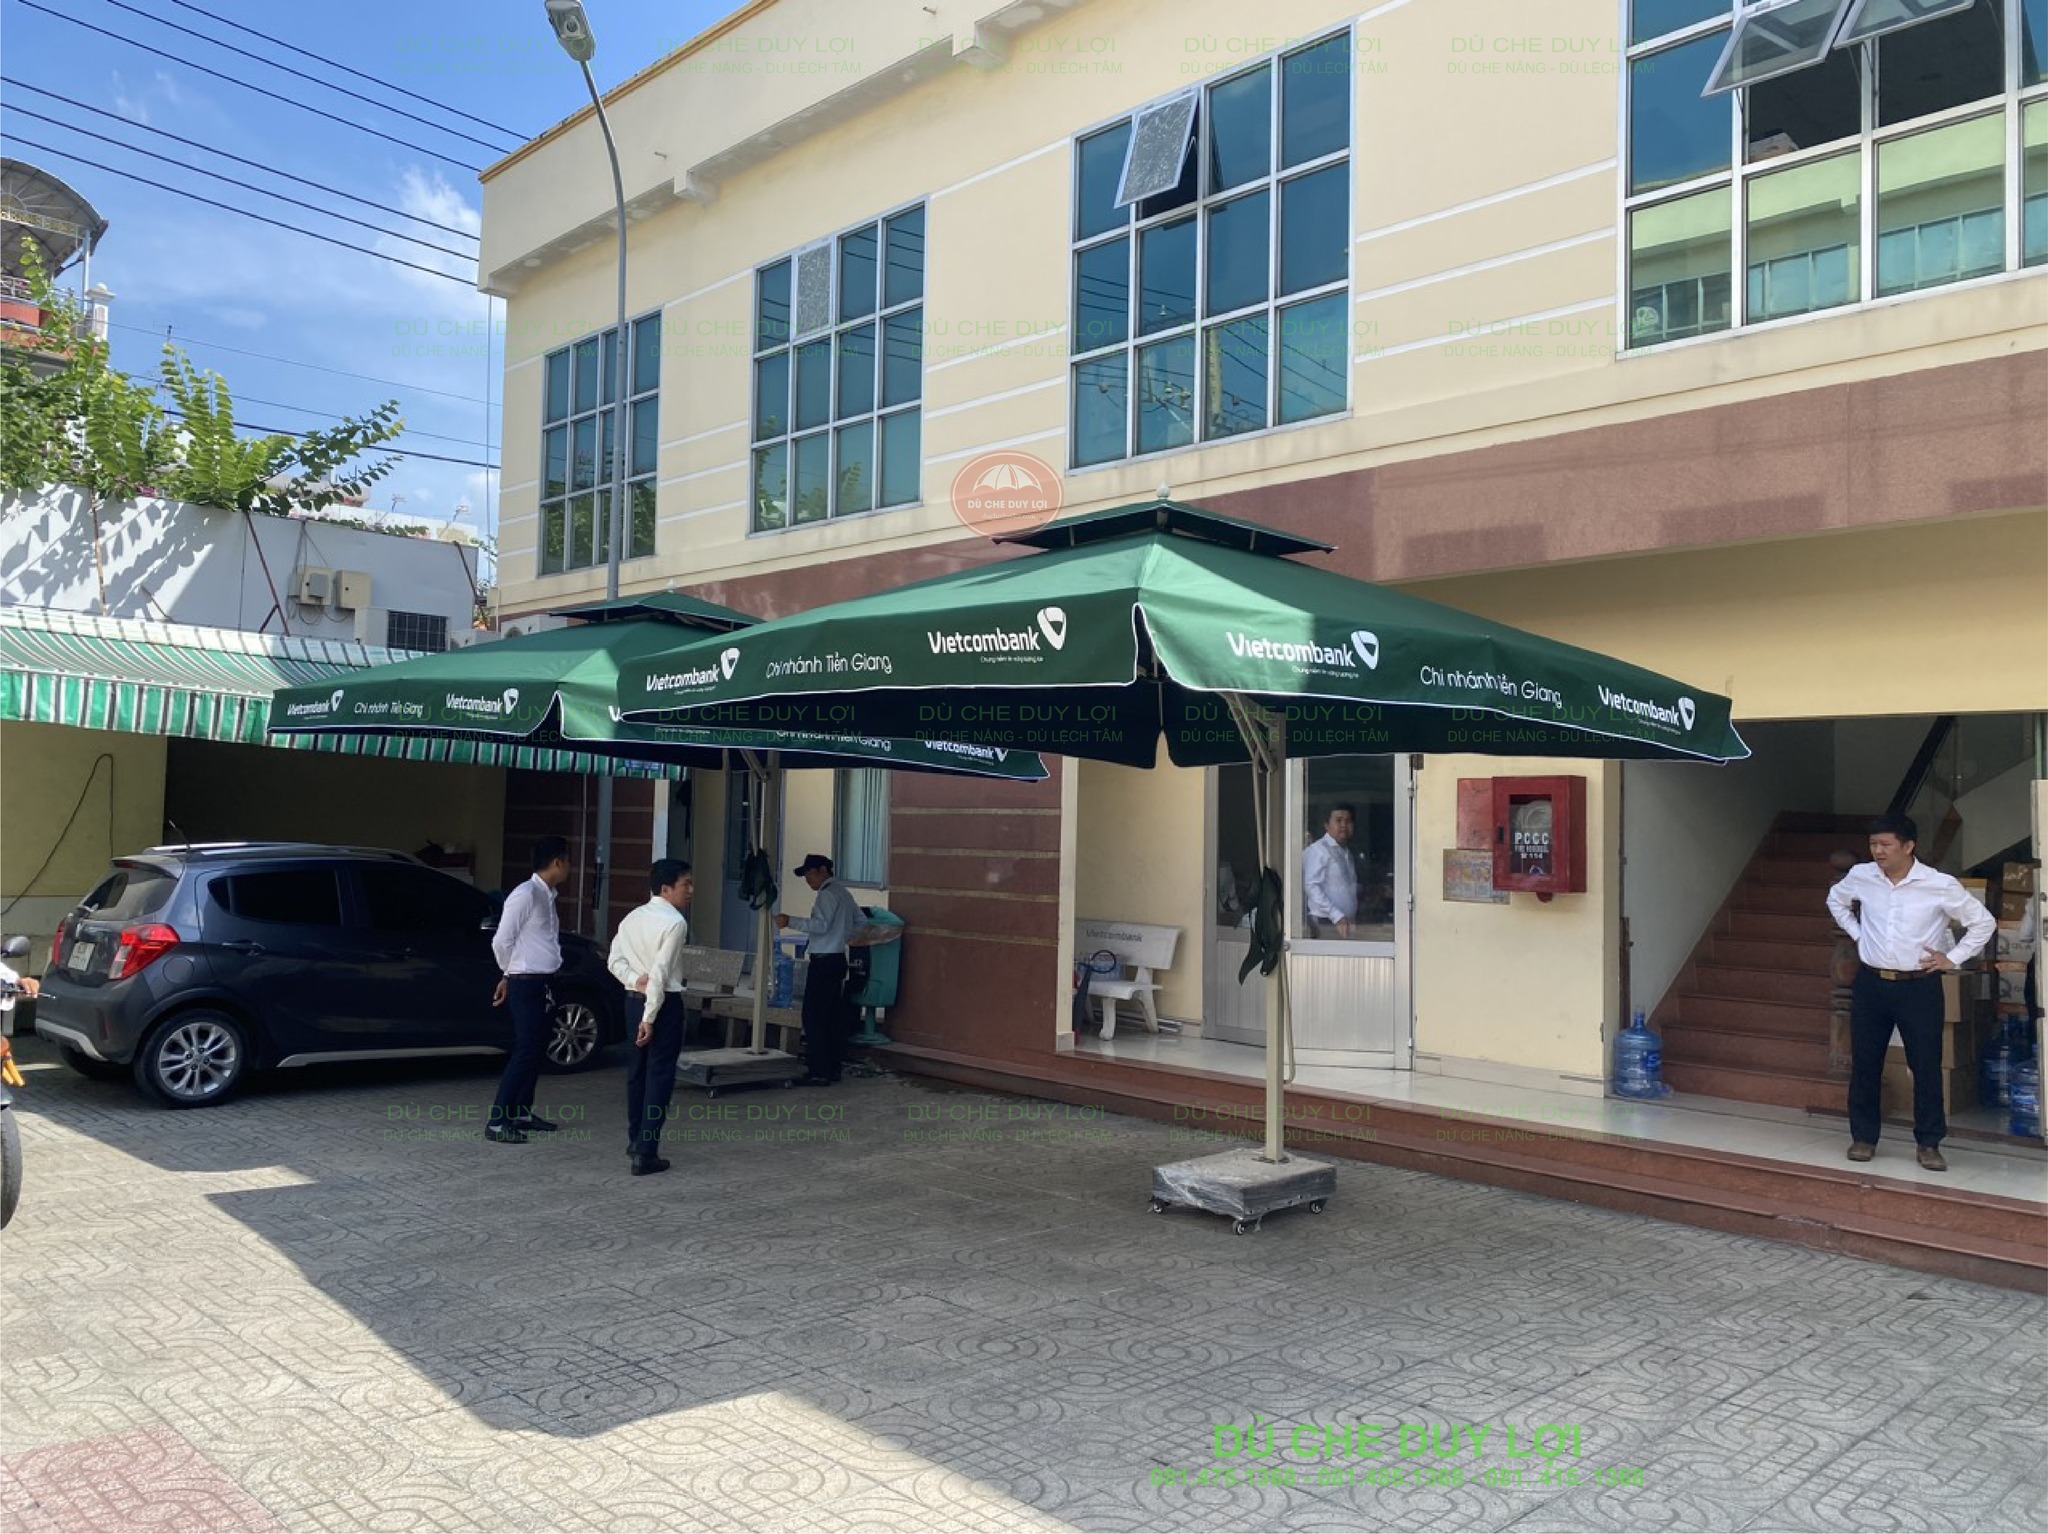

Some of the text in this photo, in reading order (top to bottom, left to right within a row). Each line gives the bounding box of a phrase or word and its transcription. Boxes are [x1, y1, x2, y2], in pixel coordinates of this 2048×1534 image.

[927, 626, 1040, 654] Vietcombank
[1226, 632, 1356, 668] Vietcombank
[782, 656, 822, 674] nhánh
[852, 653, 892, 674] Giang
[646, 664, 720, 692] Vietcombank
[1420, 666, 1445, 686] Chi
[1447, 670, 1498, 690] nhánh
[1521, 680, 1562, 709] Giang
[446, 692, 502, 713] Vietcombank
[1598, 684, 1680, 726] Vietcombank
[1514, 832, 1550, 845] PCCC
